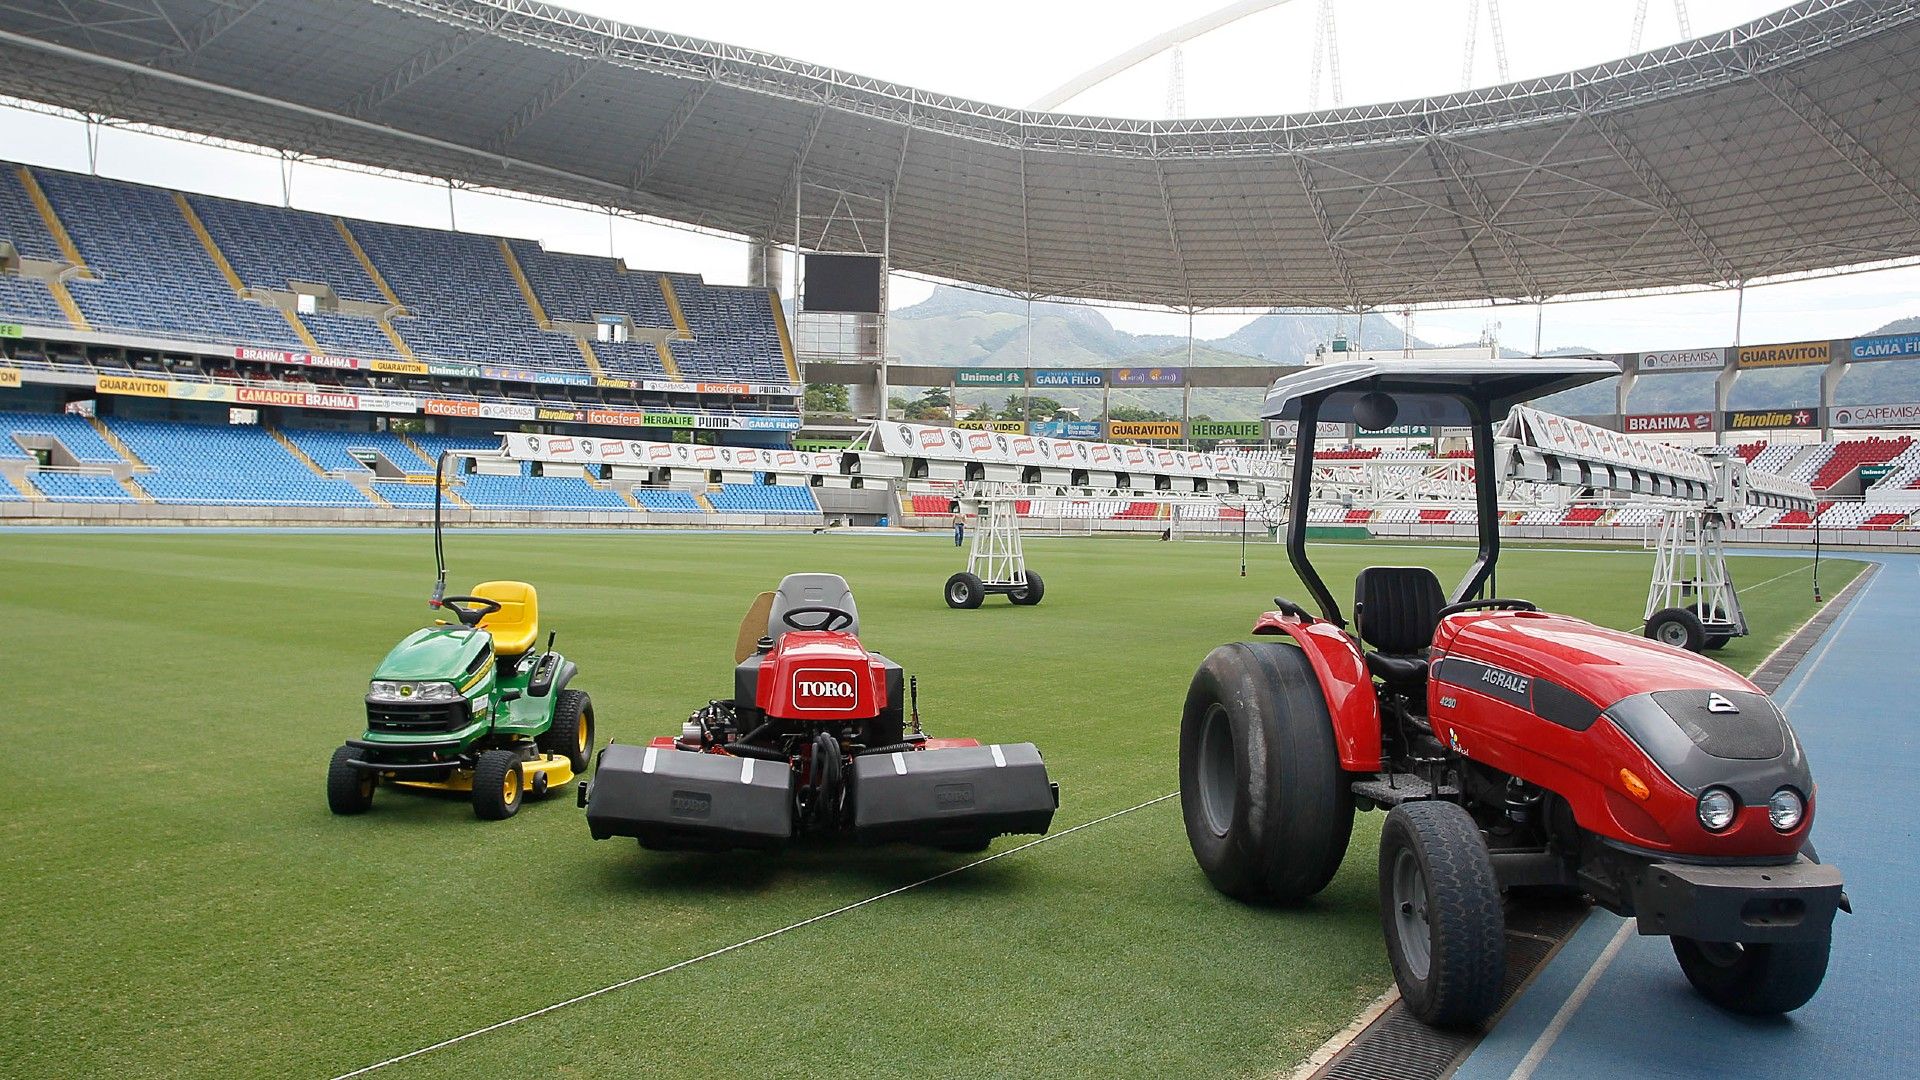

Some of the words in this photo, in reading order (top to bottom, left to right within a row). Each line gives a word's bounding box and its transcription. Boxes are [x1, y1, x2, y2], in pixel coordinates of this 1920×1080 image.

[1740, 346, 1827, 363] GUARAVITON
[1854, 343, 1902, 357] GAMA
[242, 349, 285, 362] BRAHMA
[310, 355, 351, 368] BRAHMA
[1660, 351, 1719, 364] CAPEMISA
[378, 362, 420, 373] GUARAVITON
[429, 365, 466, 376] Unimed
[540, 376, 563, 385] GAMA
[565, 377, 588, 386] FILHO
[596, 377, 629, 388] Havoline
[961, 372, 1003, 382] Unimed
[1036, 375, 1069, 385] GAMA
[1071, 375, 1100, 385] FILHO
[100, 379, 166, 393] GUARAVITON
[703, 383, 743, 393] fotosfera
[759, 385, 781, 394] PUMA
[239, 389, 304, 404] CAMAROTE
[305, 393, 355, 408] BRAHMA
[427, 401, 478, 416] fotosfera
[538, 408, 575, 420] Havoline
[1854, 405, 1920, 421] CAPEMISA
[589, 411, 640, 425] fotosfera
[643, 415, 692, 425] HERBALIFE
[698, 416, 729, 428] PUMA
[1629, 416, 1691, 430] BRAHMA
[1733, 412, 1793, 428] Havoline
[749, 420, 774, 428] GAMA
[776, 421, 799, 429] FILHO
[1112, 425, 1179, 435] GUARAVITON
[1192, 424, 1259, 436] HERBALIFE
[1481, 668, 1528, 694] AGRALE
[1439, 696, 1457, 708] 4230
